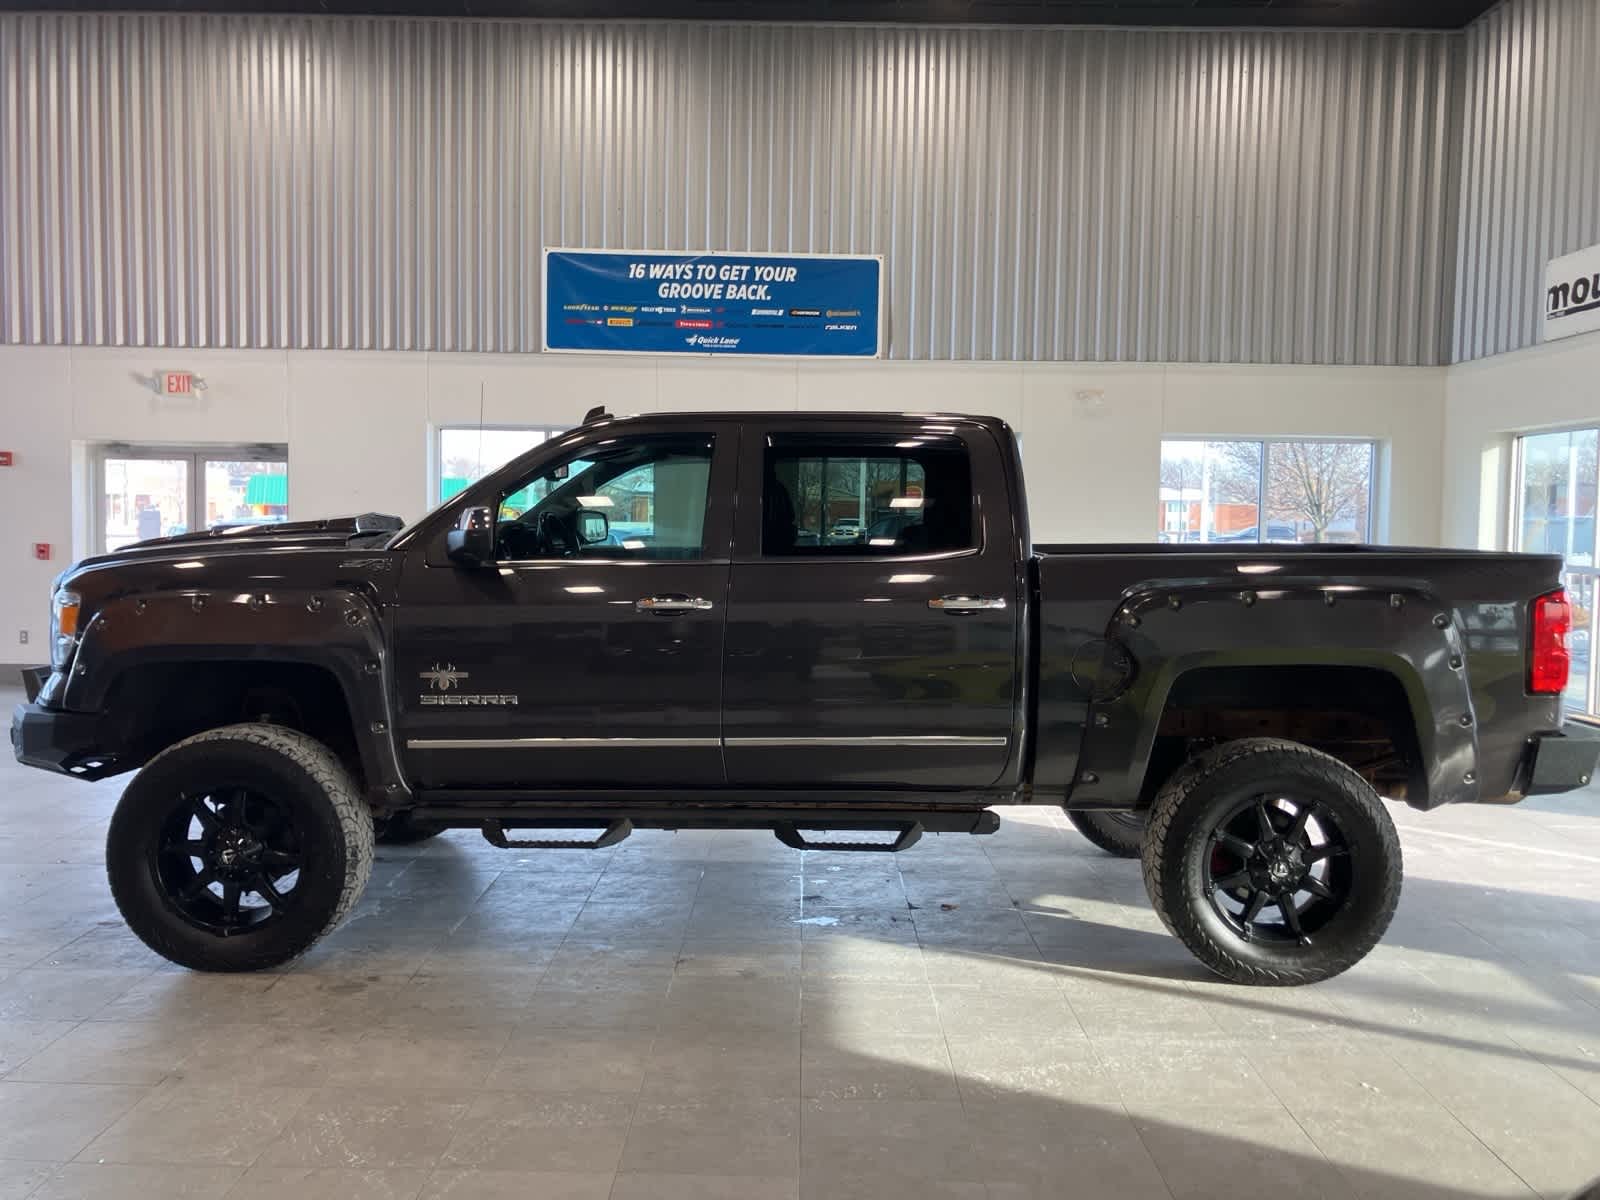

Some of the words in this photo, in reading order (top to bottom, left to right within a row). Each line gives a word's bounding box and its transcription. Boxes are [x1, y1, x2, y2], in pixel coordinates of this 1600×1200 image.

[629, 263, 646, 279] 16
[649, 264, 694, 280] WAYS
[696, 264, 717, 280] TO
[719, 265, 751, 281] GET
[754, 266, 797, 282] YOUR
[658, 282, 724, 300] GROOVE
[725, 284, 772, 301] BACK.
[697, 336, 720, 345] Quick
[720, 336, 740, 345] Lane
[167, 374, 192, 393] EXIT
[420, 694, 519, 705] SIERRA
